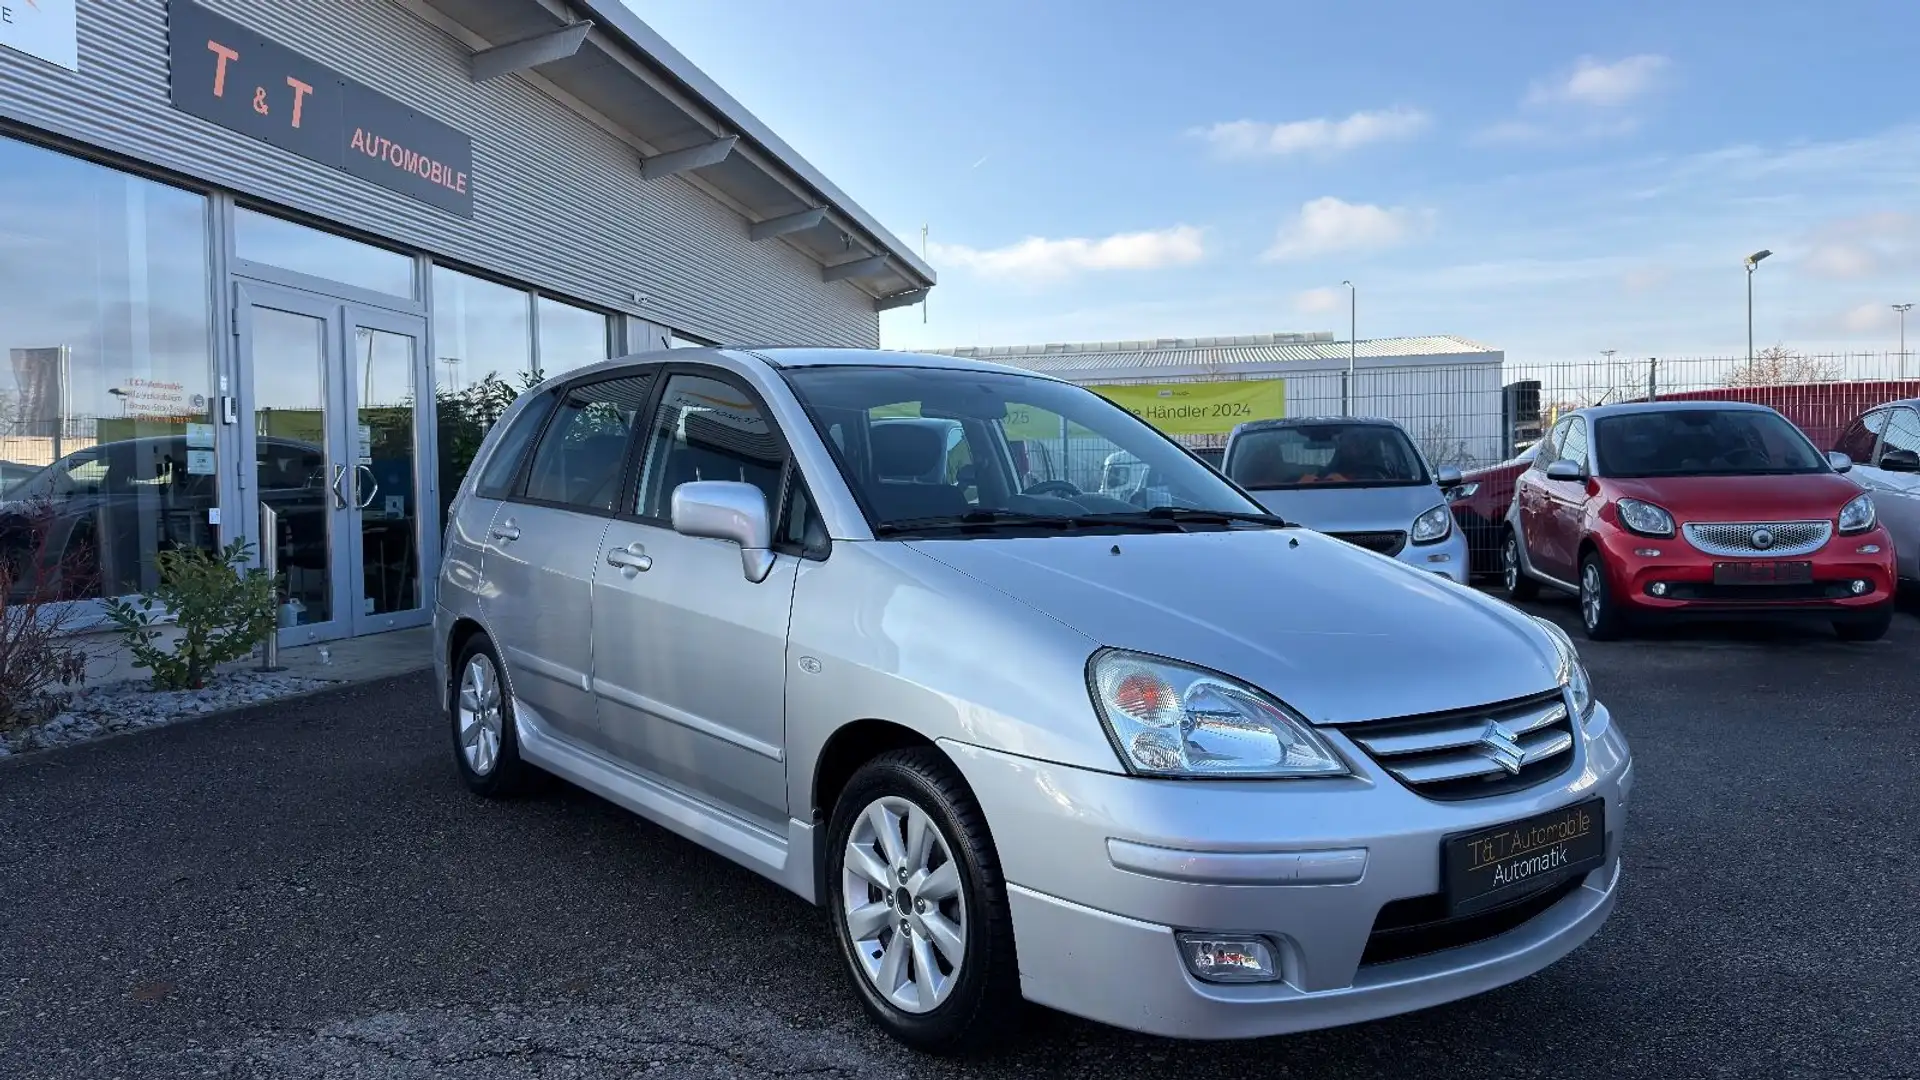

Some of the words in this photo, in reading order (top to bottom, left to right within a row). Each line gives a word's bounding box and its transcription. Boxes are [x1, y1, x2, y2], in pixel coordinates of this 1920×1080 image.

[208, 39, 239, 98] T
[253, 86, 269, 116] &
[286, 76, 313, 129] T
[350, 127, 467, 195] AUTOMOBILE
[1146, 404, 1209, 419] Händler
[1211, 403, 1251, 417] 2024
[1510, 810, 1590, 853] Automobile
[1493, 842, 1568, 887] Automatik
